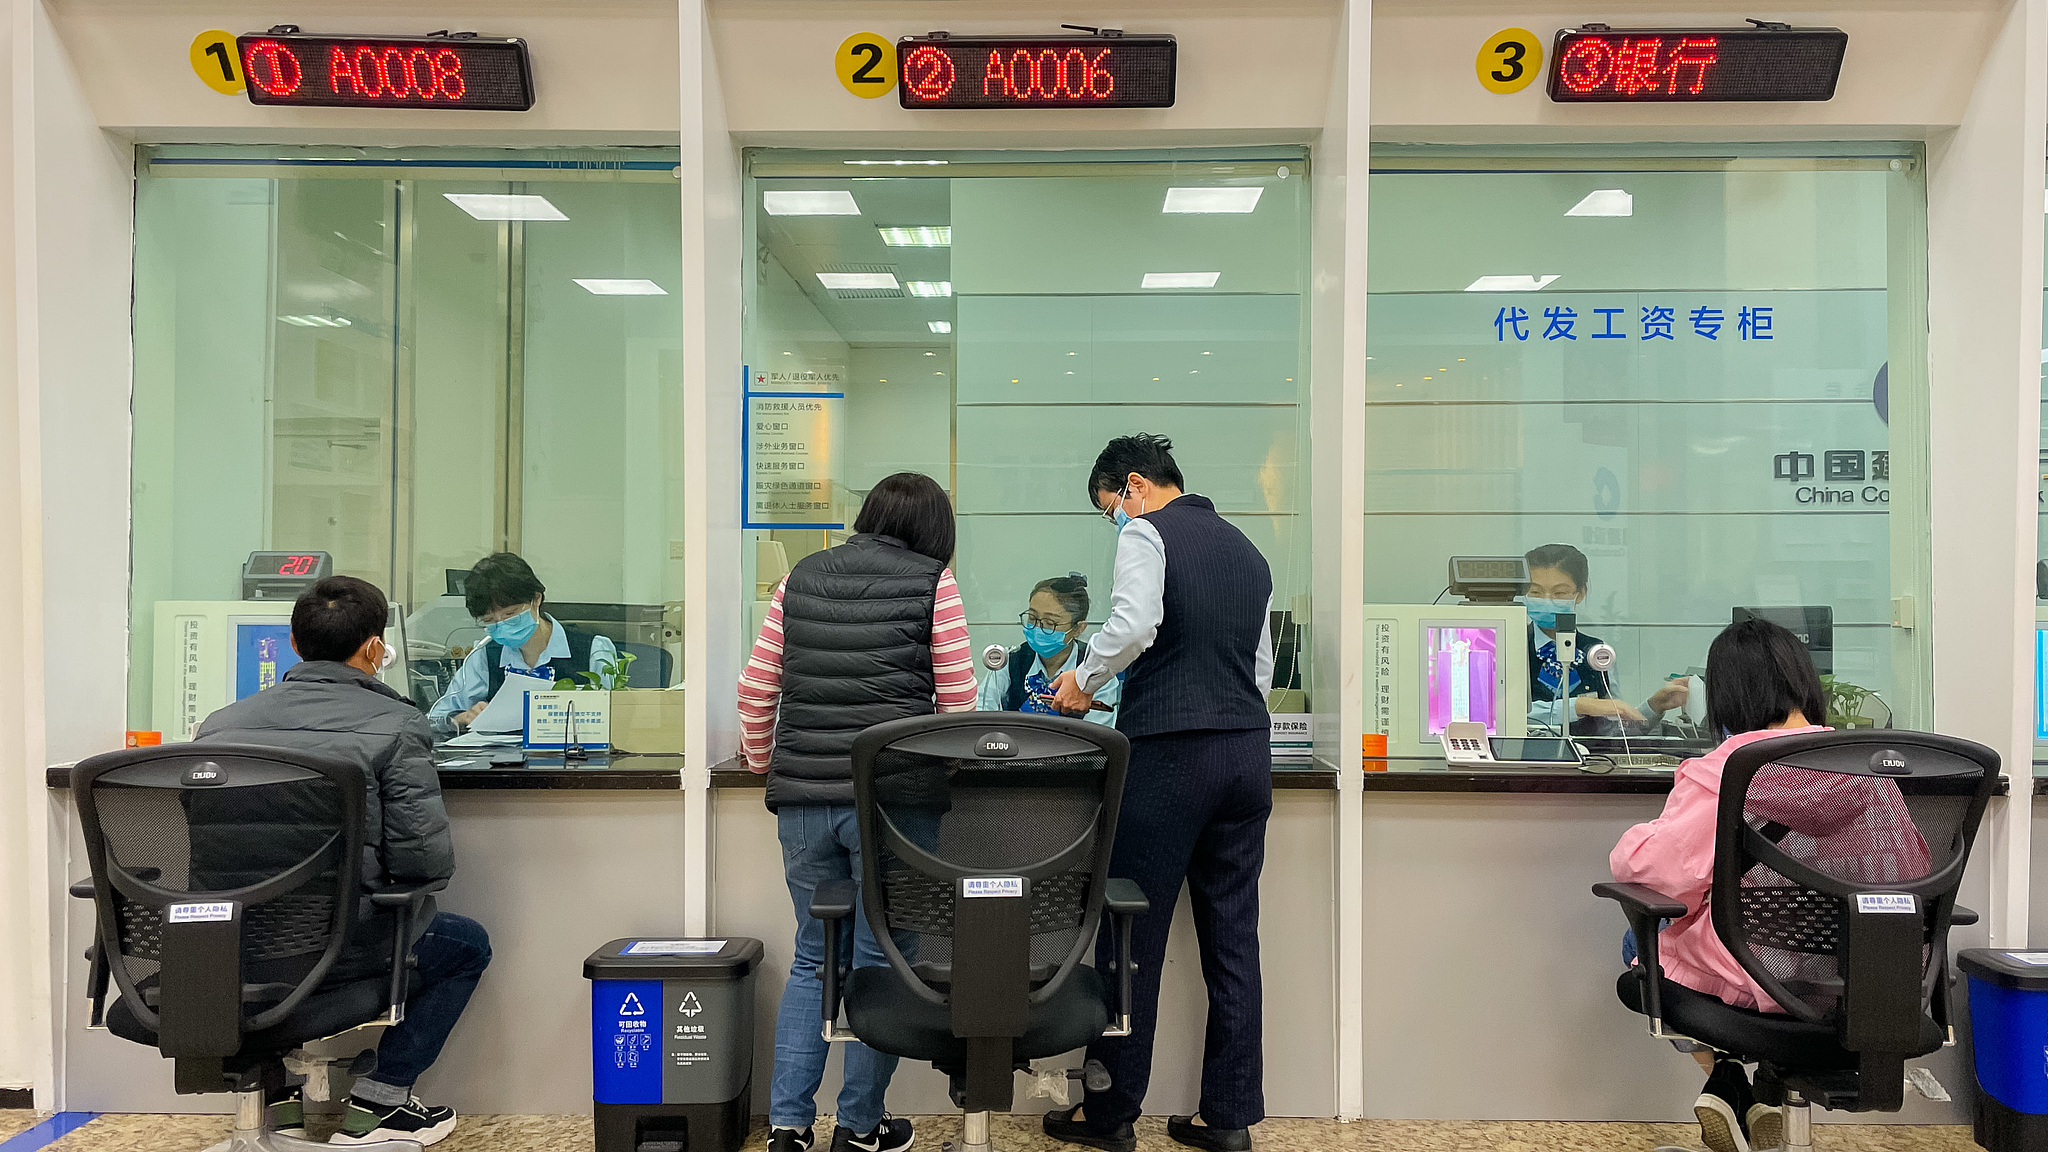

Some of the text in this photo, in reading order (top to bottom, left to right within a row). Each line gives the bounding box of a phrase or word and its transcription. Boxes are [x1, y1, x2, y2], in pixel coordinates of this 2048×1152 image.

[205, 42, 236, 82] 1
[851, 43, 885, 84] 2
[1491, 42, 1526, 82] 3
[330, 45, 465, 100] A0008
[984, 48, 1114, 99] A0006
[1493, 306, 1775, 341] 代发工资专柜
[756, 402, 822, 411] 消防救援人员优先
[756, 422, 789, 431] 爱心窗口
[756, 442, 805, 451] 涉外业务窗口
[756, 462, 805, 470] 快速服务窗口
[1796, 486, 1854, 503] China
[279, 556, 315, 575] 20
[1381, 623, 1390, 676] 投资有风险
[188, 682, 196, 734] 理财需谨
[1273, 722, 1308, 731] 存款保险
[968, 880, 1018, 888] 请尊重个人隐私
[175, 905, 228, 914] 请尊重个人隐私
[618, 1020, 647, 1028] 可回收物
[676, 1025, 705, 1033] 其他垃圾
